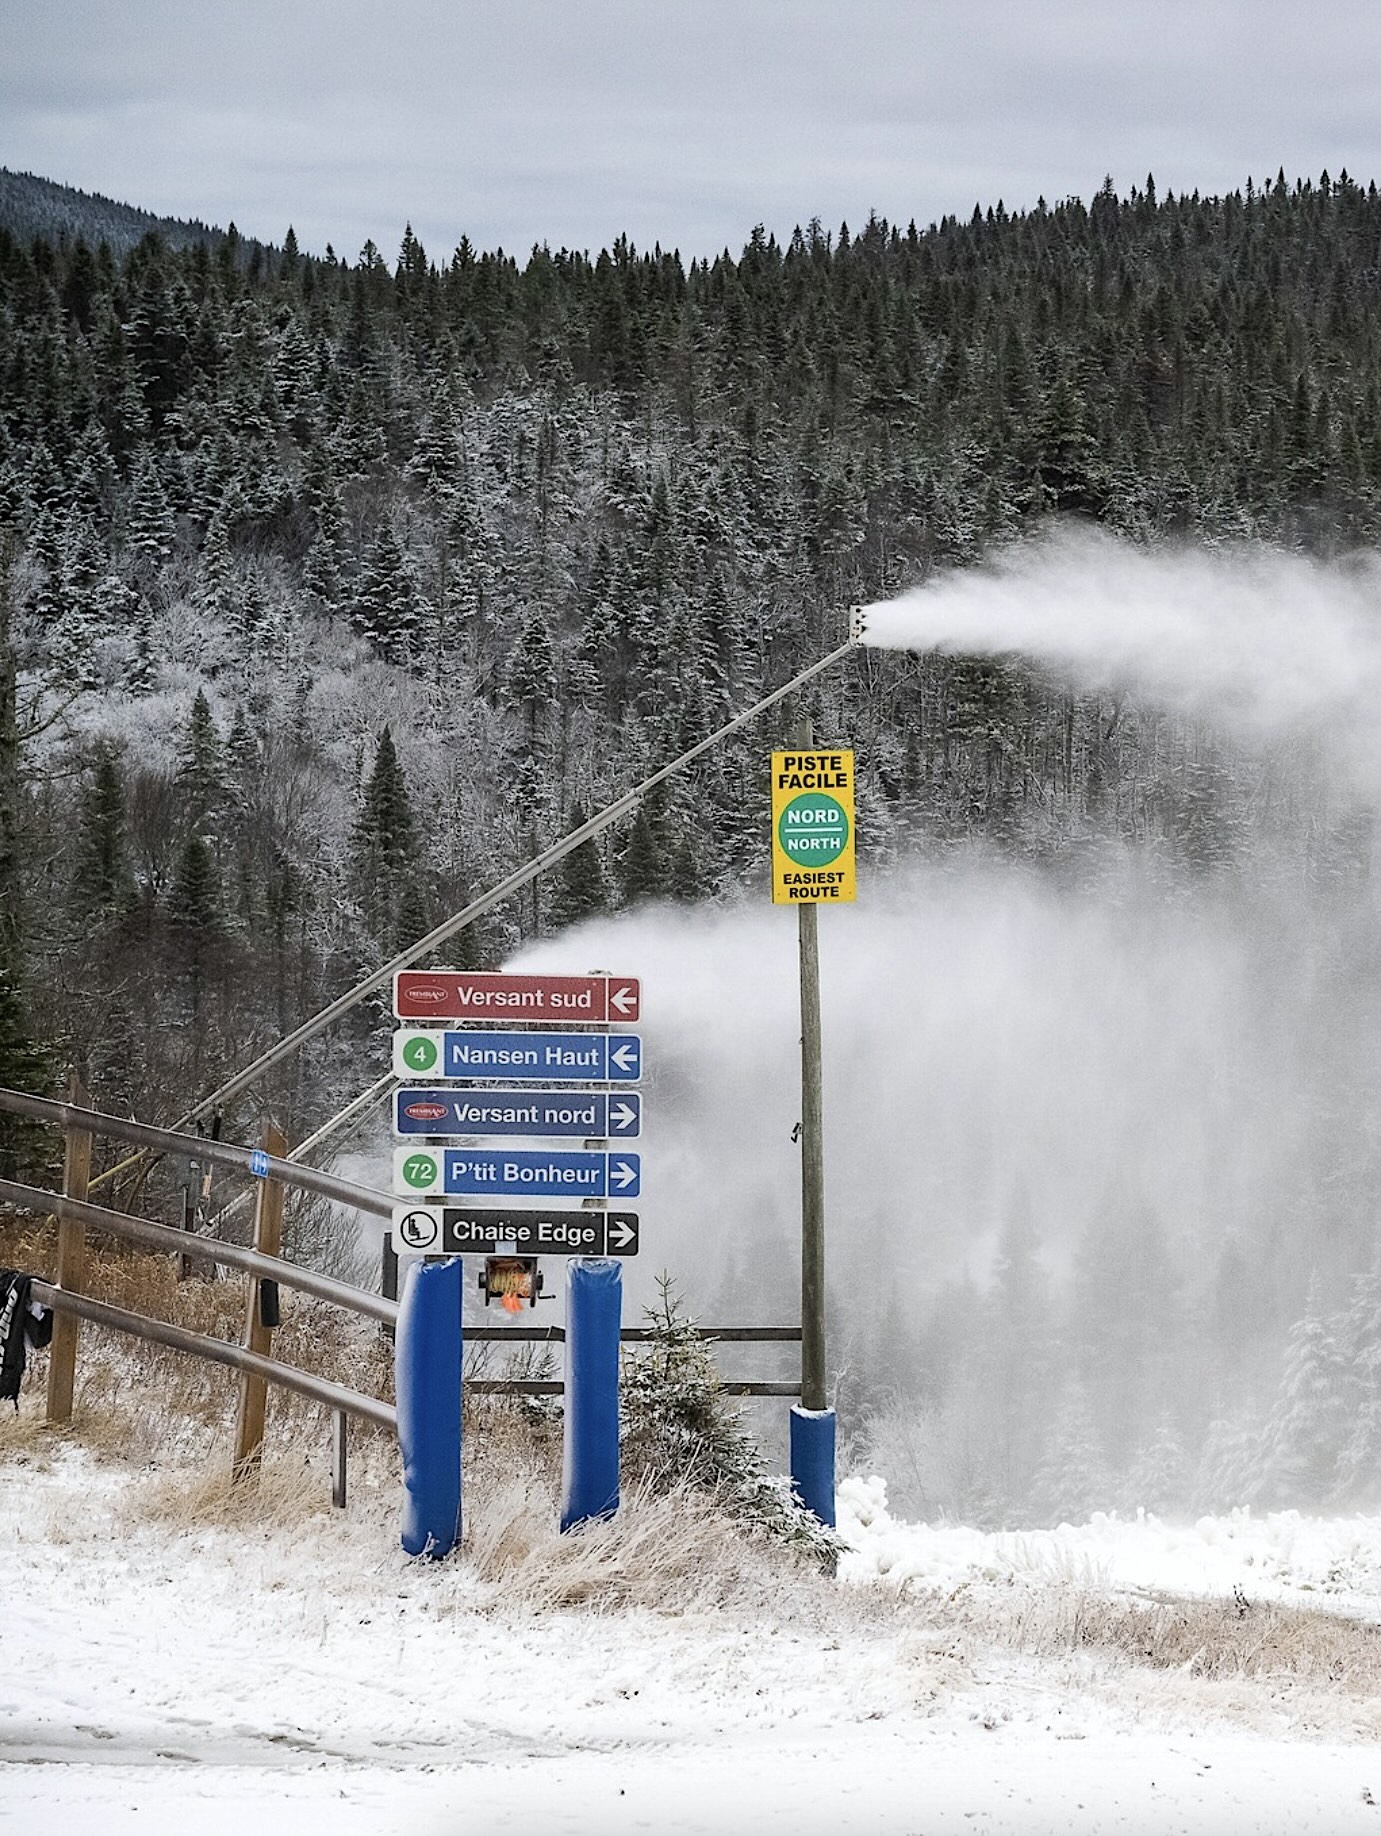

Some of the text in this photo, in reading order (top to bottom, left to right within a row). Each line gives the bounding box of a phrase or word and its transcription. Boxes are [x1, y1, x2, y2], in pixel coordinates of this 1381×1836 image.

[784, 756, 842, 771] PISTE
[778, 773, 848, 789] FACILE
[787, 809, 840, 824] NORD
[788, 837, 841, 851] NORTH
[783, 872, 845, 885] EASIEST
[789, 886, 840, 899] ROUTE
[457, 986, 592, 1008] Versant sud
[413, 1045, 427, 1062] 4
[452, 1045, 599, 1066] Nansen Haut
[453, 1103, 595, 1124] Versant nord
[408, 1163, 433, 1180] 72
[452, 1162, 600, 1183] P'tit Bonheur
[452, 1220, 596, 1245] Chaise Edge
